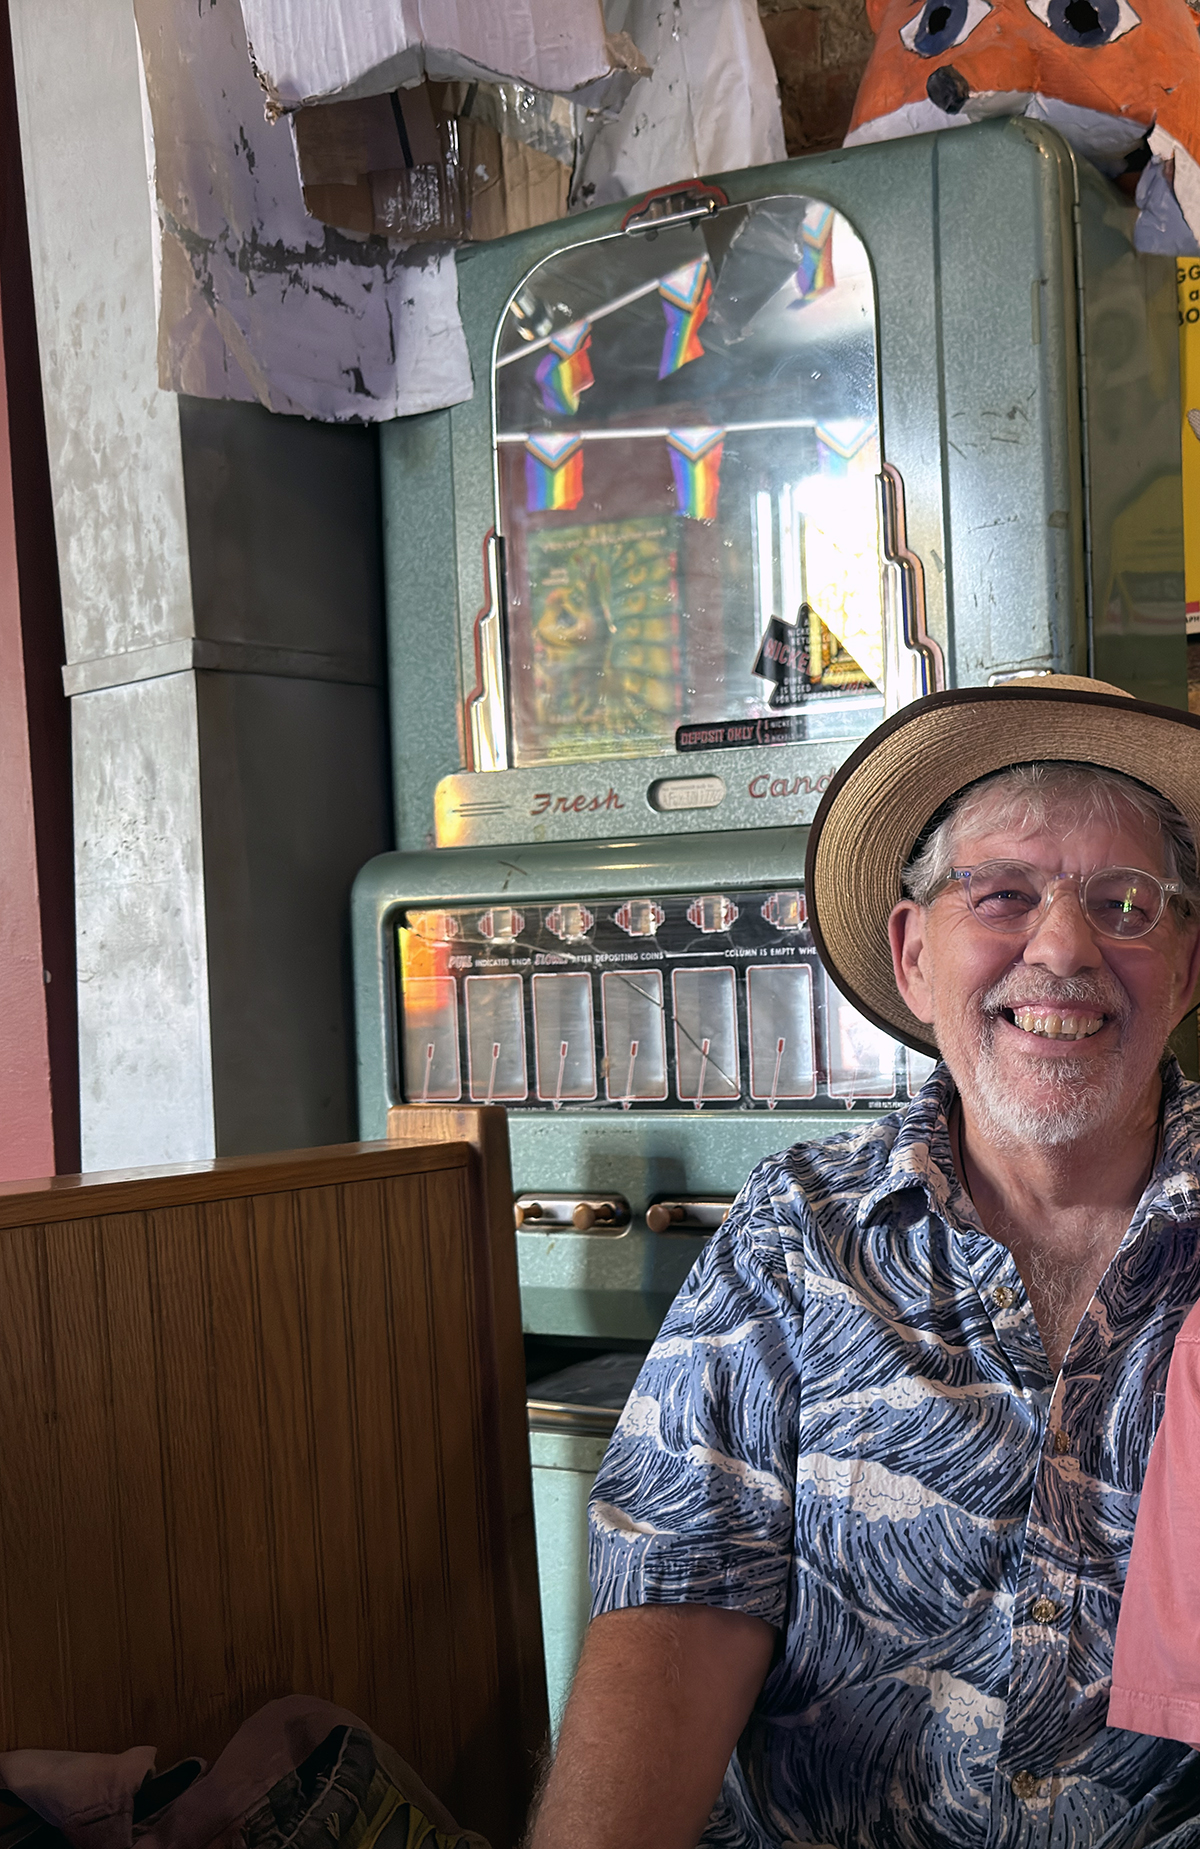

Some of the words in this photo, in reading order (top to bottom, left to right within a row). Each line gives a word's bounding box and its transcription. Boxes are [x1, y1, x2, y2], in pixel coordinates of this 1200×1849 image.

[681, 728, 724, 745] DEPOSIT
[727, 726, 754, 740] ONLY
[749, 768, 836, 799] Cand
[530, 788, 624, 816] Fresh
[594, 952, 638, 964] DEPOSITING
[640, 952, 663, 961] COINS
[724, 948, 757, 958] COLUMN
[759, 948, 767, 957] IS
[770, 948, 795, 957] EMPTY
[798, 946, 818, 956] WHE
